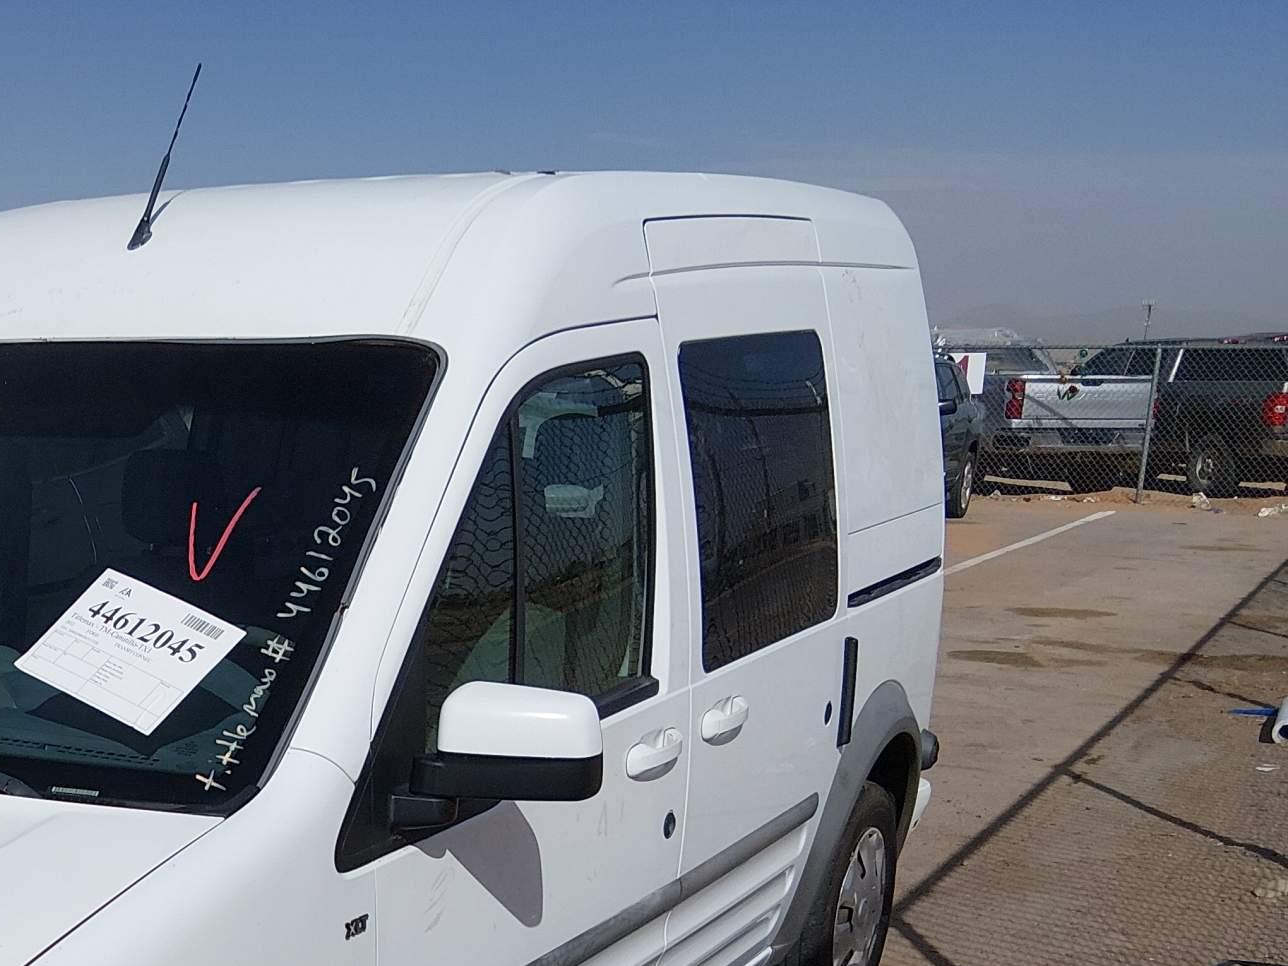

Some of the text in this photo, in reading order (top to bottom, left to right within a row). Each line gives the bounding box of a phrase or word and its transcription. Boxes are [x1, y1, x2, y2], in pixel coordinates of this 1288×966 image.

[276, 466, 378, 620] 44612045
[88, 600, 206, 665] 44612045
[261, 634, 294, 664] #
